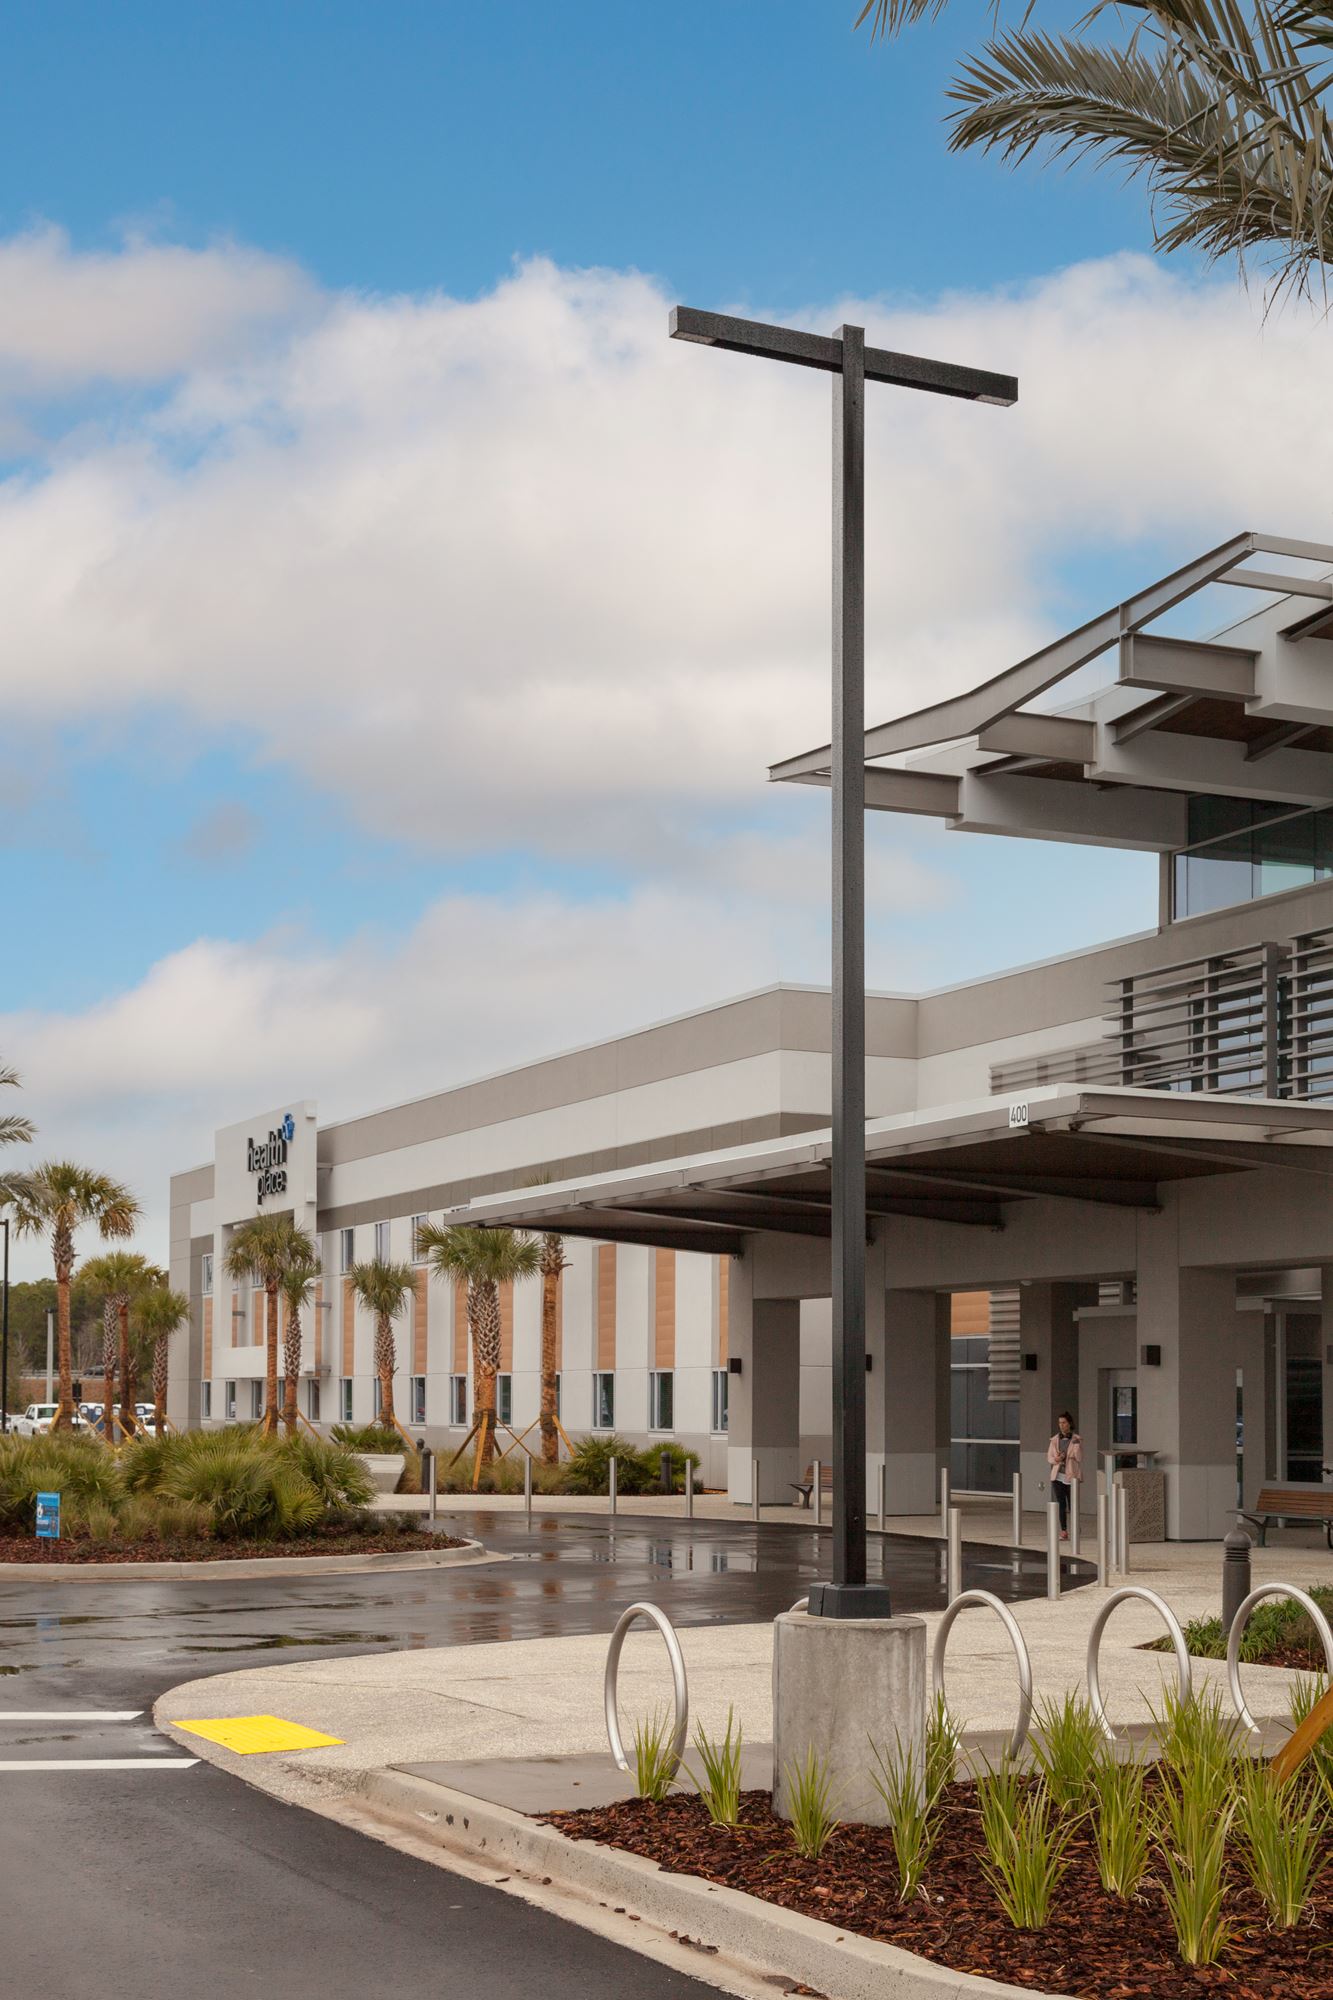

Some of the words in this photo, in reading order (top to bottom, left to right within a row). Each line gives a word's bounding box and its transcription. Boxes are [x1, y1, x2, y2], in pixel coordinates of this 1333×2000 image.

[1010, 1105, 1027, 1123] 400
[248, 1128, 287, 1172] health
[257, 1169, 287, 1205] place
